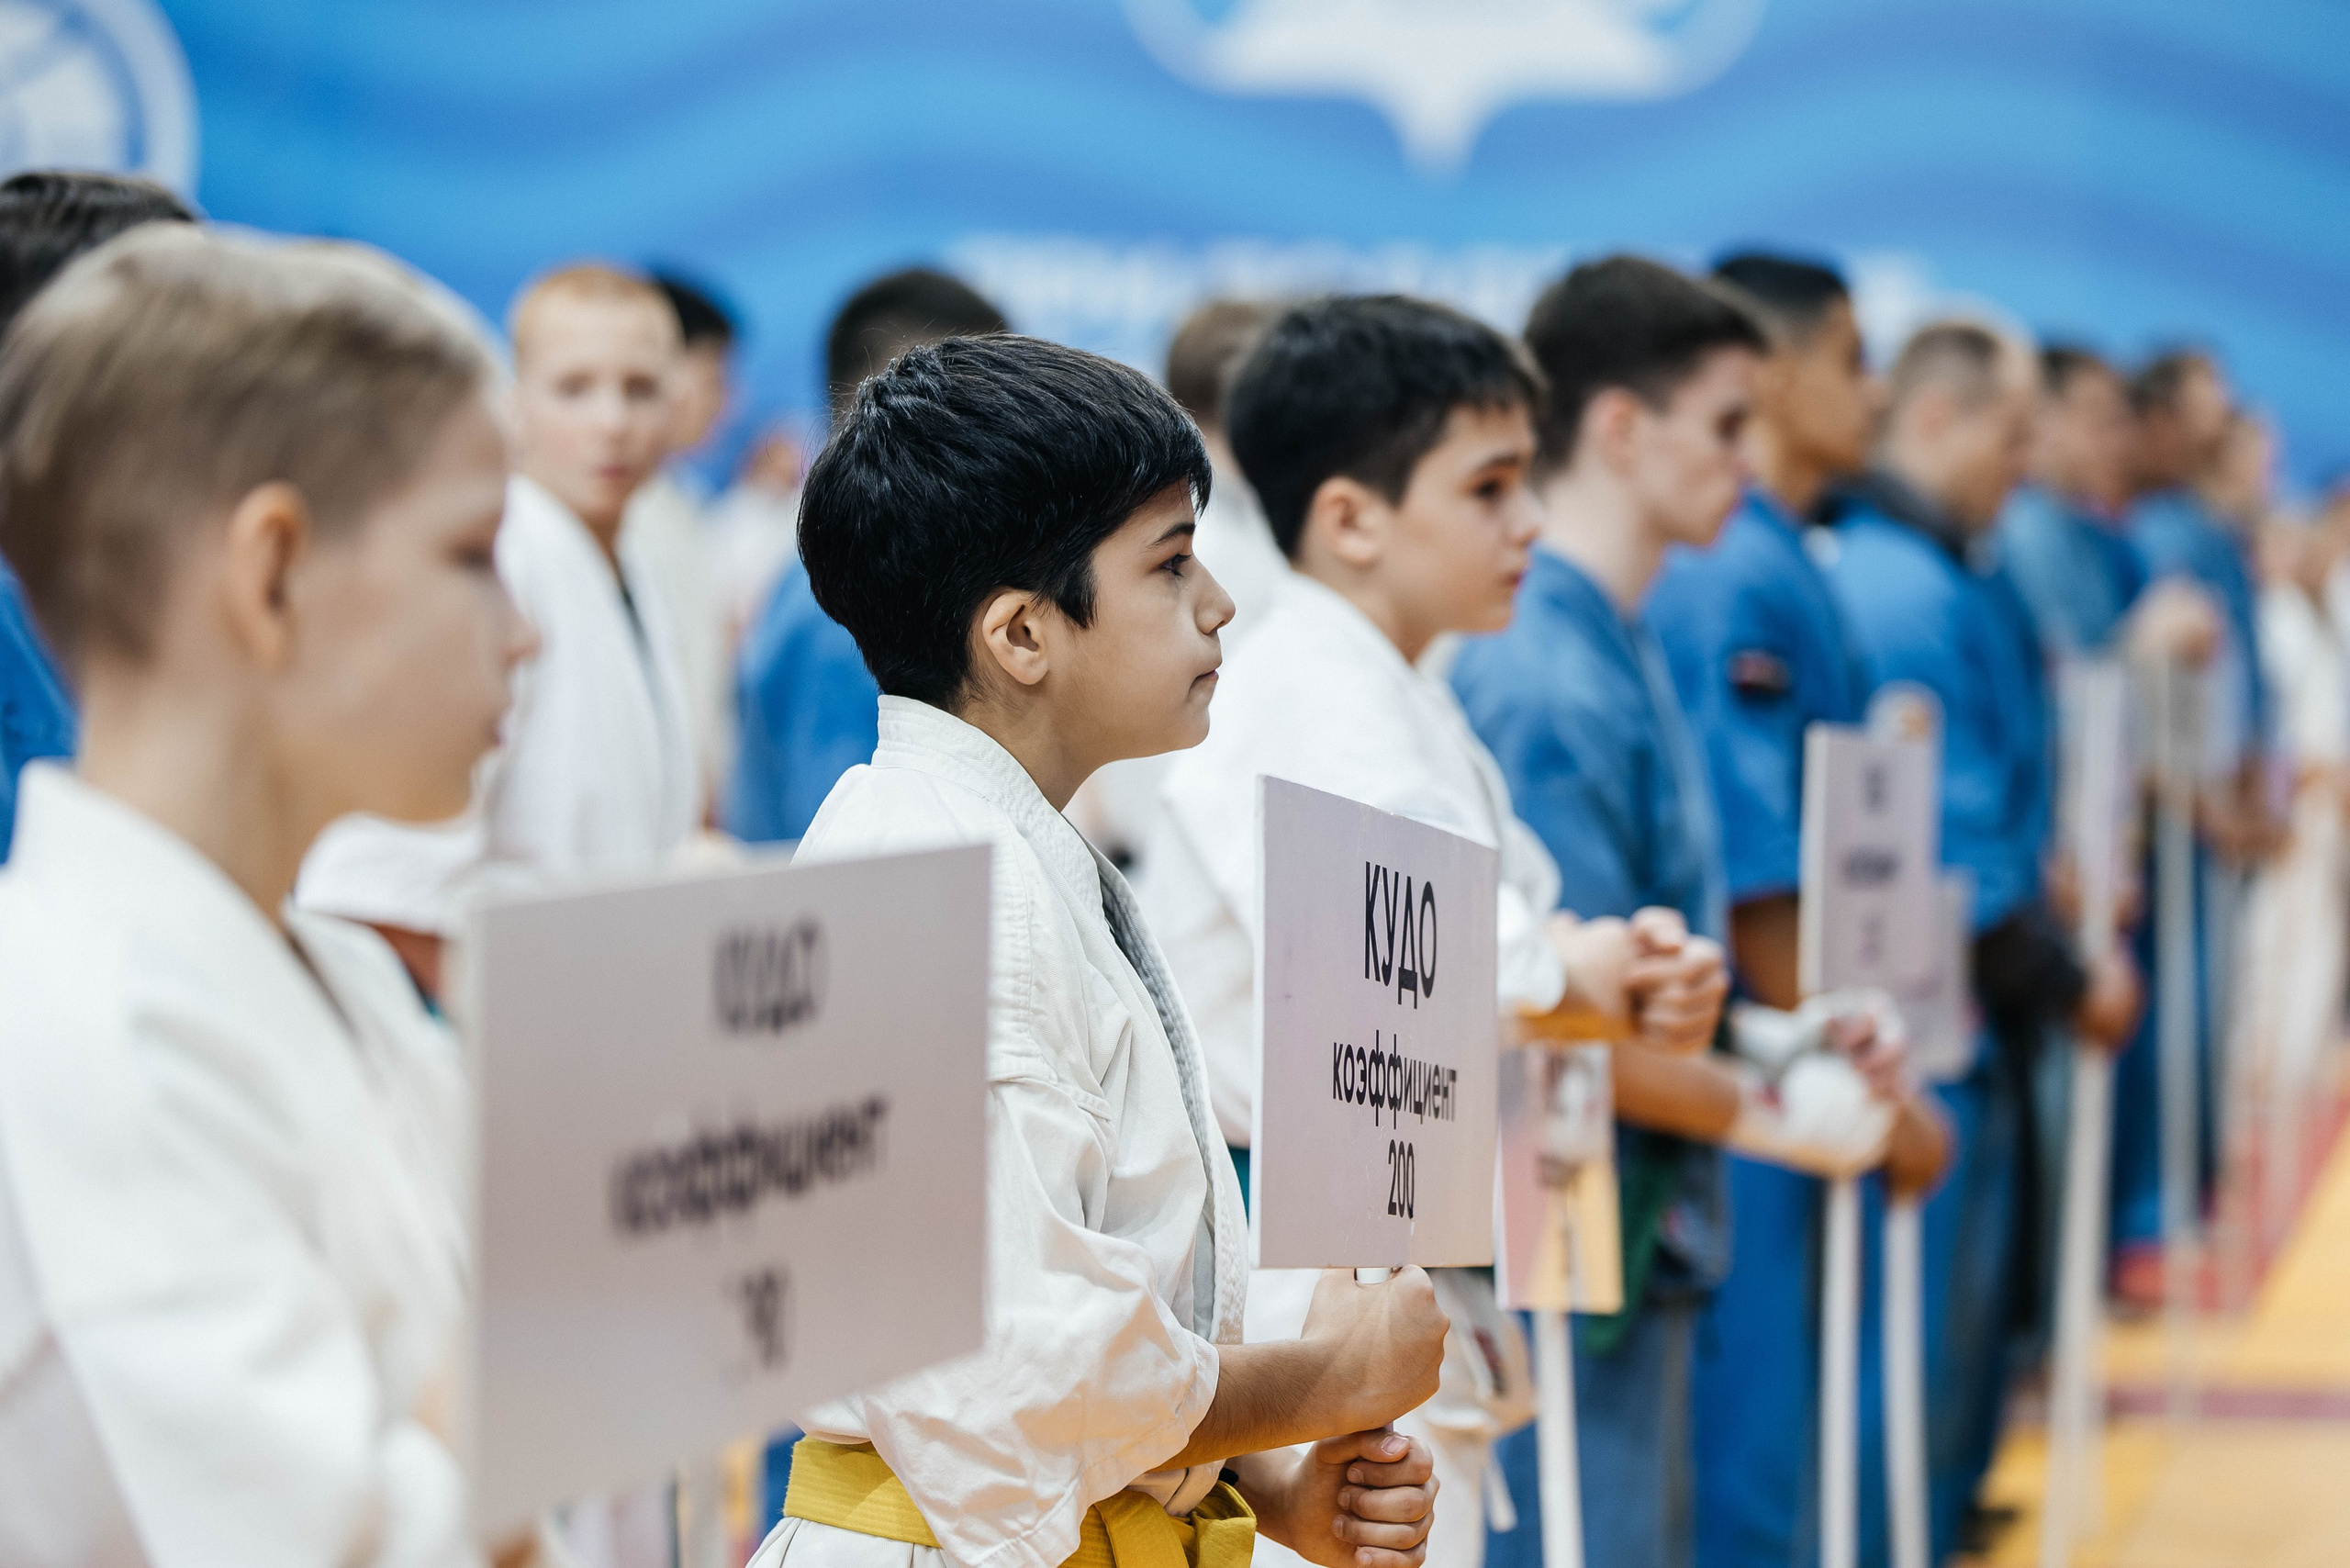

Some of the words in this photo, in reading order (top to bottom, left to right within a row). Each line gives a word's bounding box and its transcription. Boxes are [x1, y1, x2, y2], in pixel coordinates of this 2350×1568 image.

[1364, 861, 1438, 1010] КУДО
[1332, 1029, 1459, 1130] коэффициент
[1387, 1138, 1416, 1220] 200
